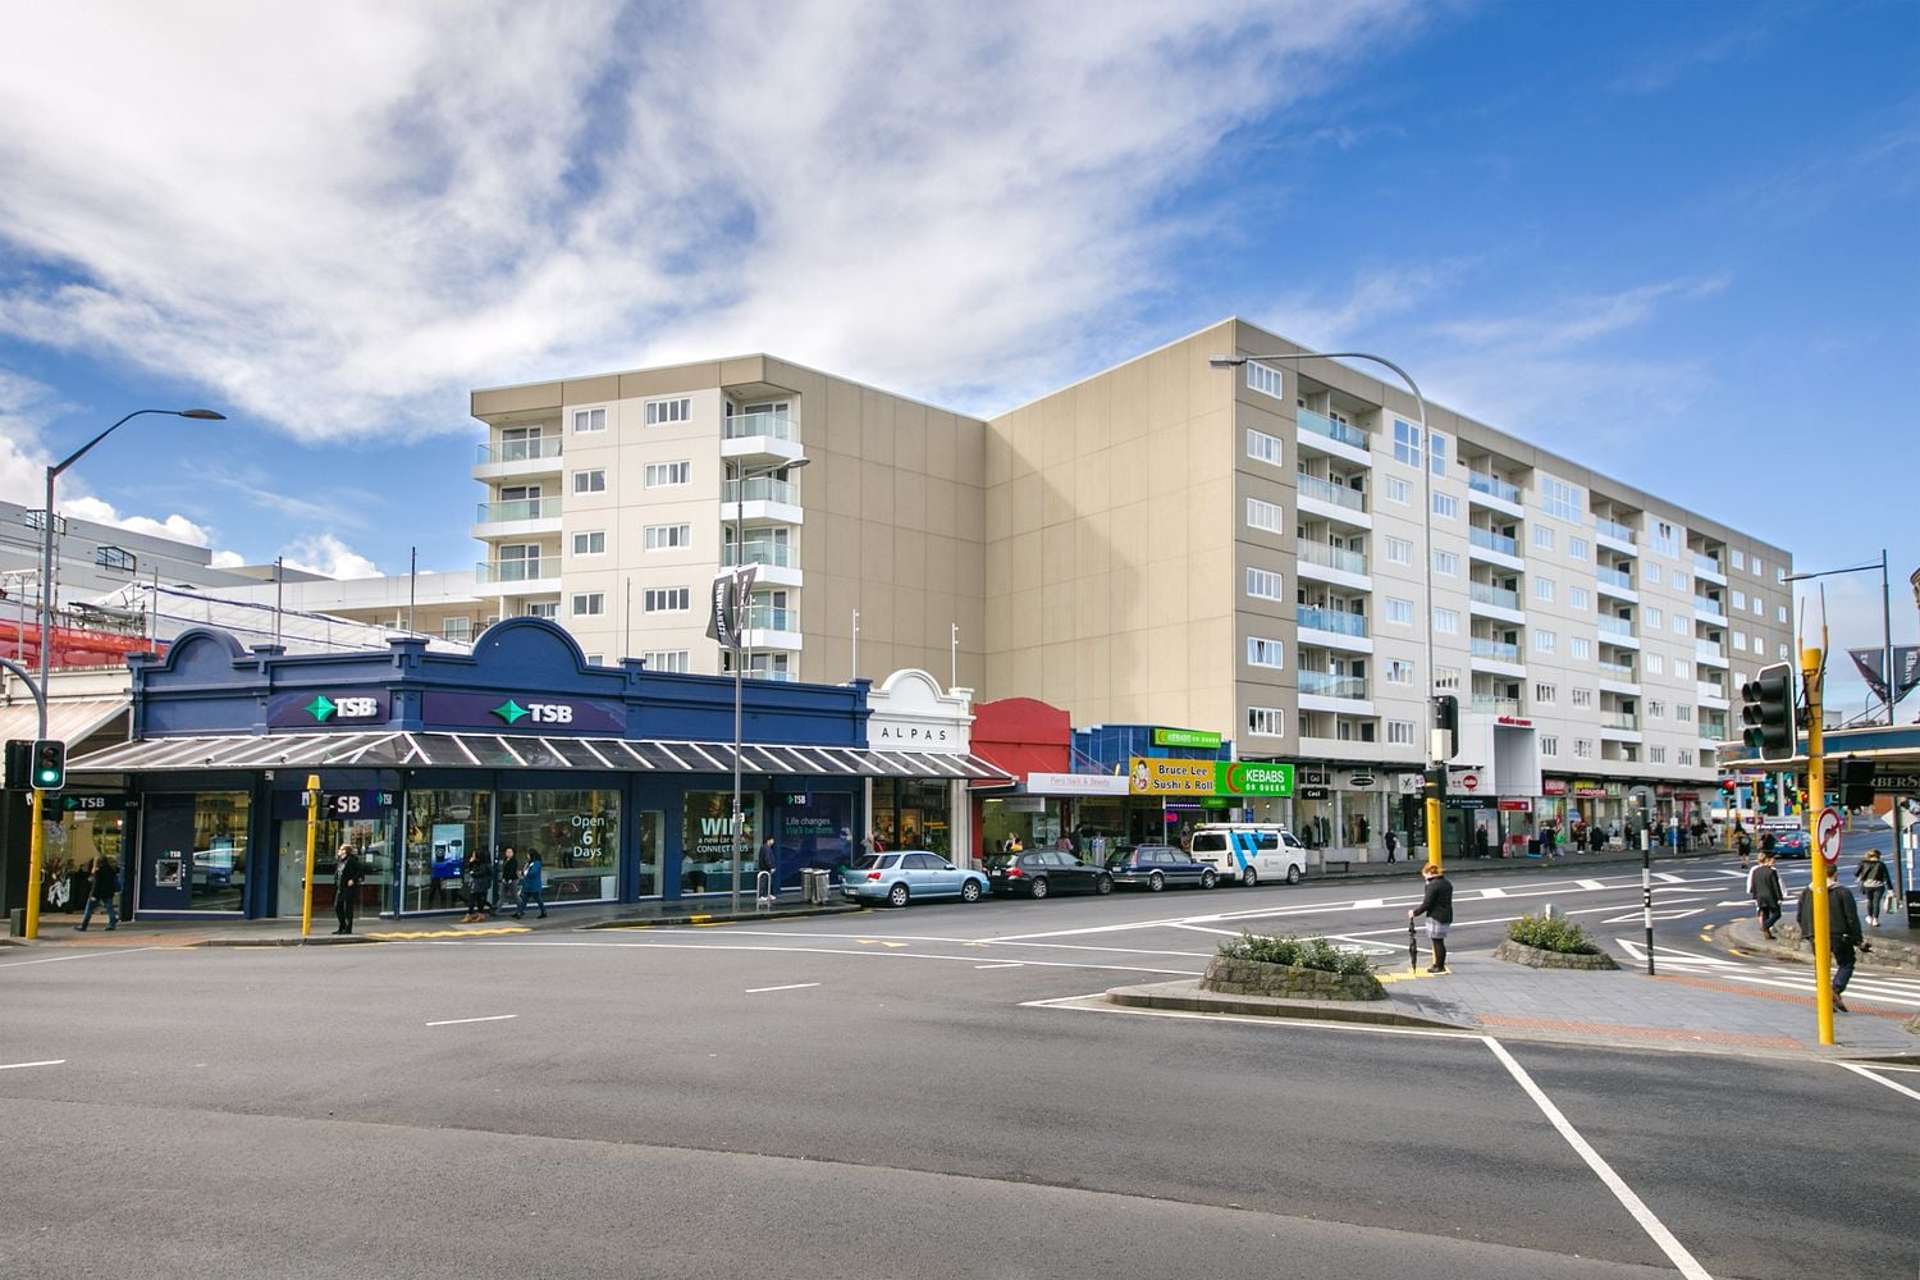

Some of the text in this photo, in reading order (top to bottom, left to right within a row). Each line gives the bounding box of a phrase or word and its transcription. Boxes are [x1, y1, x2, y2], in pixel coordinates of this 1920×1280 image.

[334, 698, 378, 717] TSB
[528, 703, 573, 723] TSB
[881, 728, 946, 741] ALPAS
[1159, 764, 1208, 775] Bruce Lee
[1246, 769, 1285, 783] KEBABS
[1153, 779, 1213, 789] Sushi & Roll
[80, 797, 105, 808] TSB
[337, 796, 360, 812] SB
[794, 795, 806, 805] TSB
[571, 815, 605, 829] Open
[582, 830, 593, 845] 6
[573, 846, 602, 860] Days
